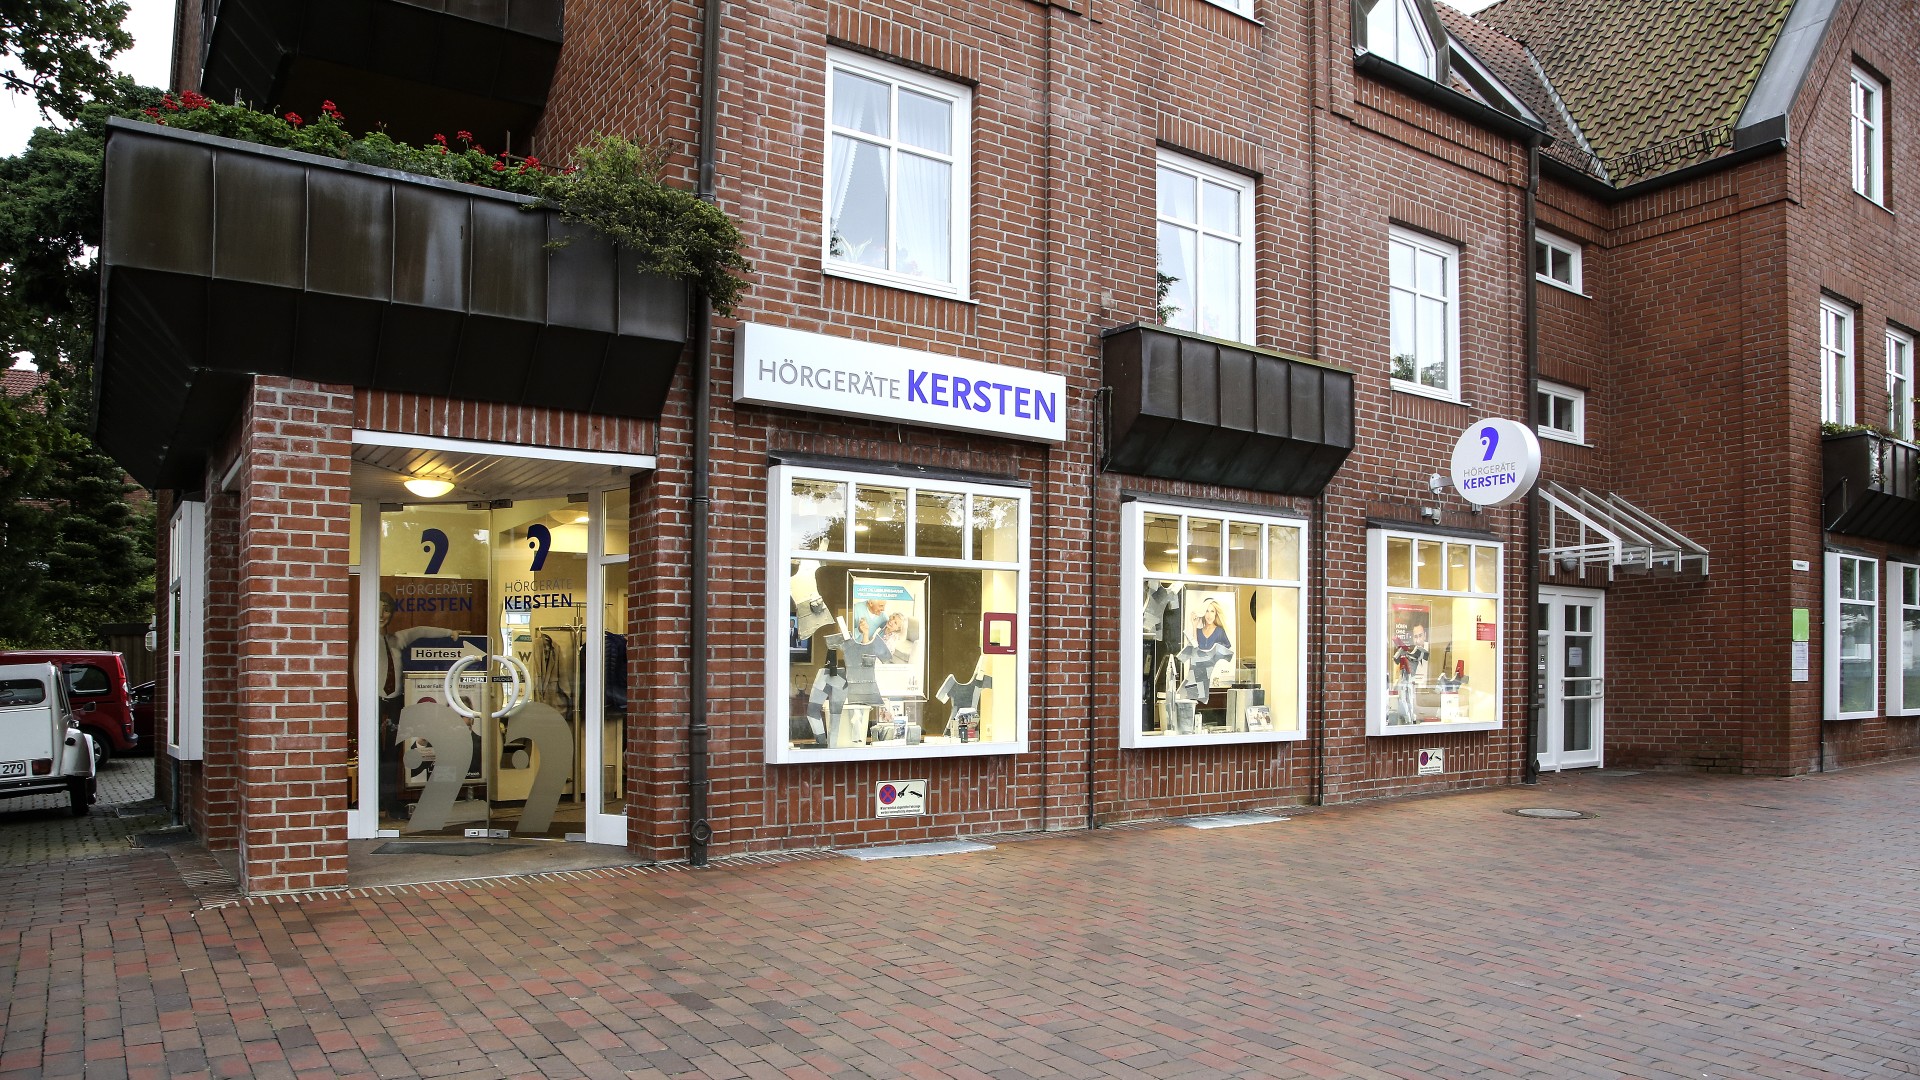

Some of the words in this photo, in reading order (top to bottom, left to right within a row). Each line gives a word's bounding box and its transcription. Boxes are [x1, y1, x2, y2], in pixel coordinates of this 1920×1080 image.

[759, 358, 900, 400] HÖRGERÄTE
[908, 368, 1056, 423] KERSTEN
[1463, 462, 1516, 478] HÖRGERÄTE
[1463, 472, 1516, 490] KERSTEN
[395, 582, 473, 595] HÖRGERÄTE
[504, 578, 573, 592] HÖRGERÄTE
[395, 596, 472, 612] KERSTEN
[504, 593, 572, 610] KERSTEN
[415, 649, 462, 658] Hörtest
[2, 764, 24, 774] 279
